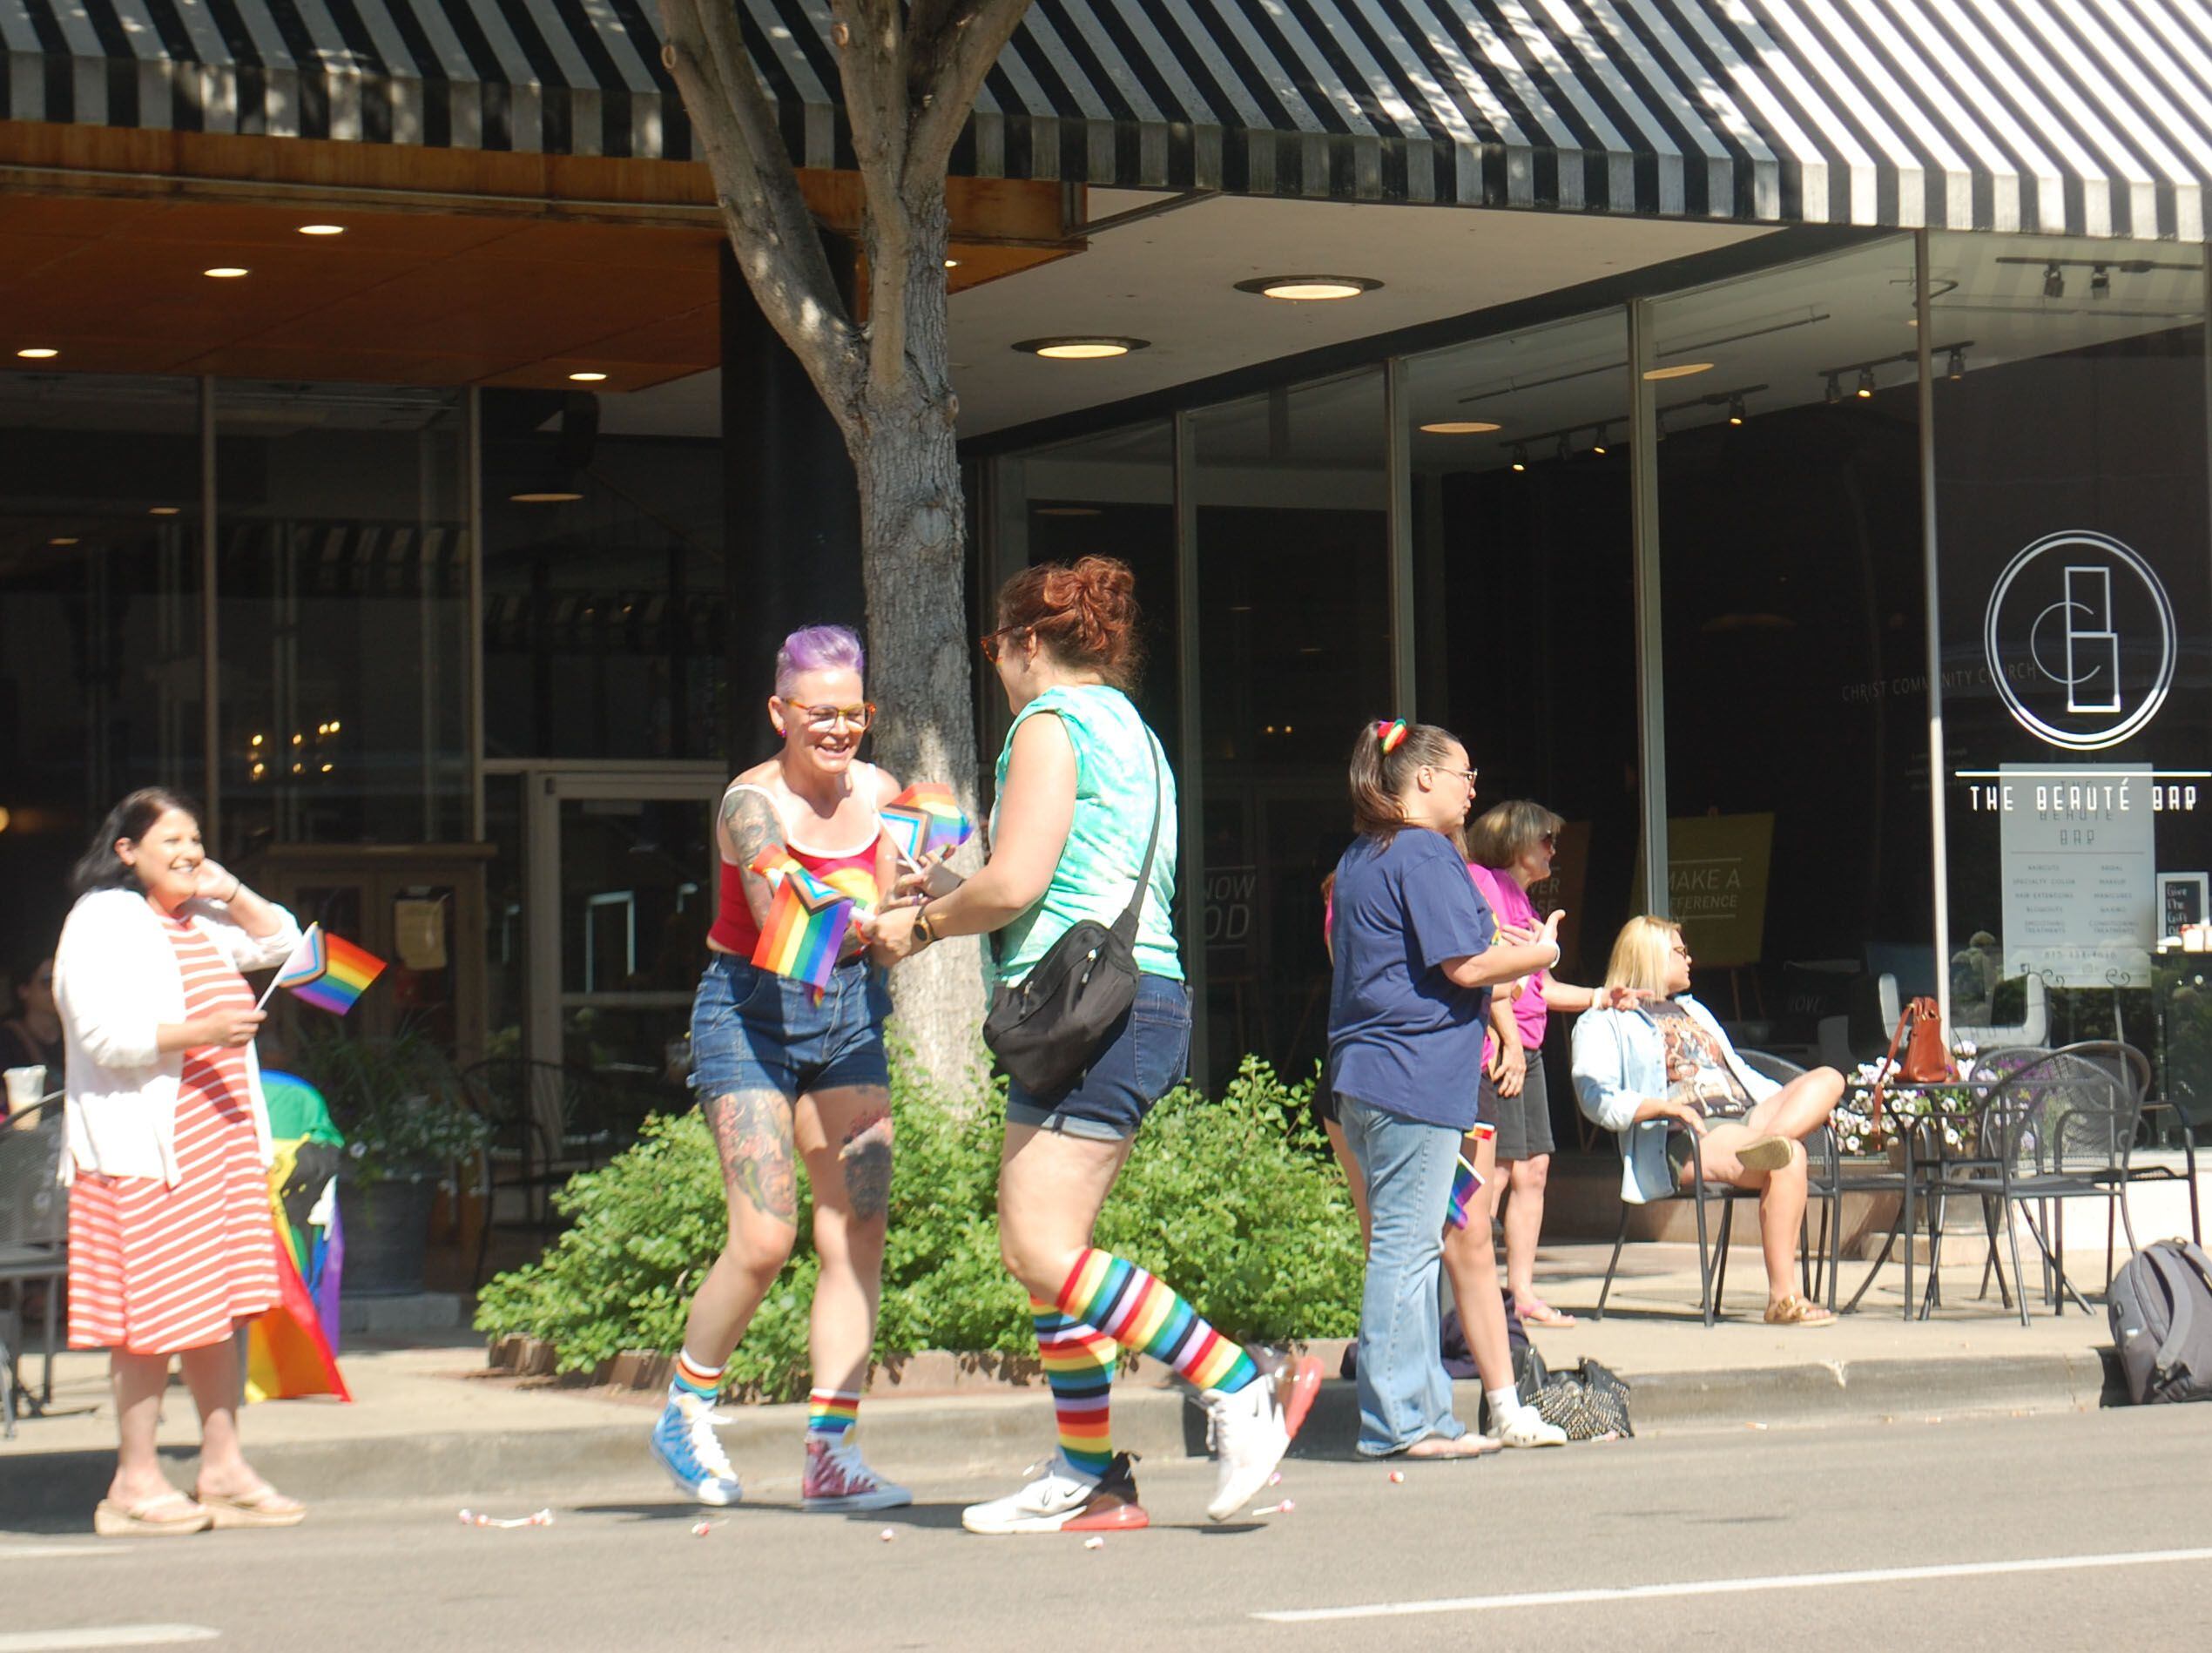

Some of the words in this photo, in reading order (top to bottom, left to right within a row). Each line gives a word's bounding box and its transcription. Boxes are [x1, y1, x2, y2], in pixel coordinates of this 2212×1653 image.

[1842, 681, 1887, 704] CHRIST
[1892, 671, 1972, 695] COMMNITY
[1979, 662, 2036, 684] CHRCH
[1970, 786, 2013, 811] THE
[2036, 777, 2129, 811] BEAUTÉ
[2152, 786, 2195, 811] BAR
[2060, 828, 2095, 846] BAR
[1726, 867, 1740, 889] A
[2166, 885, 2188, 897] Give
